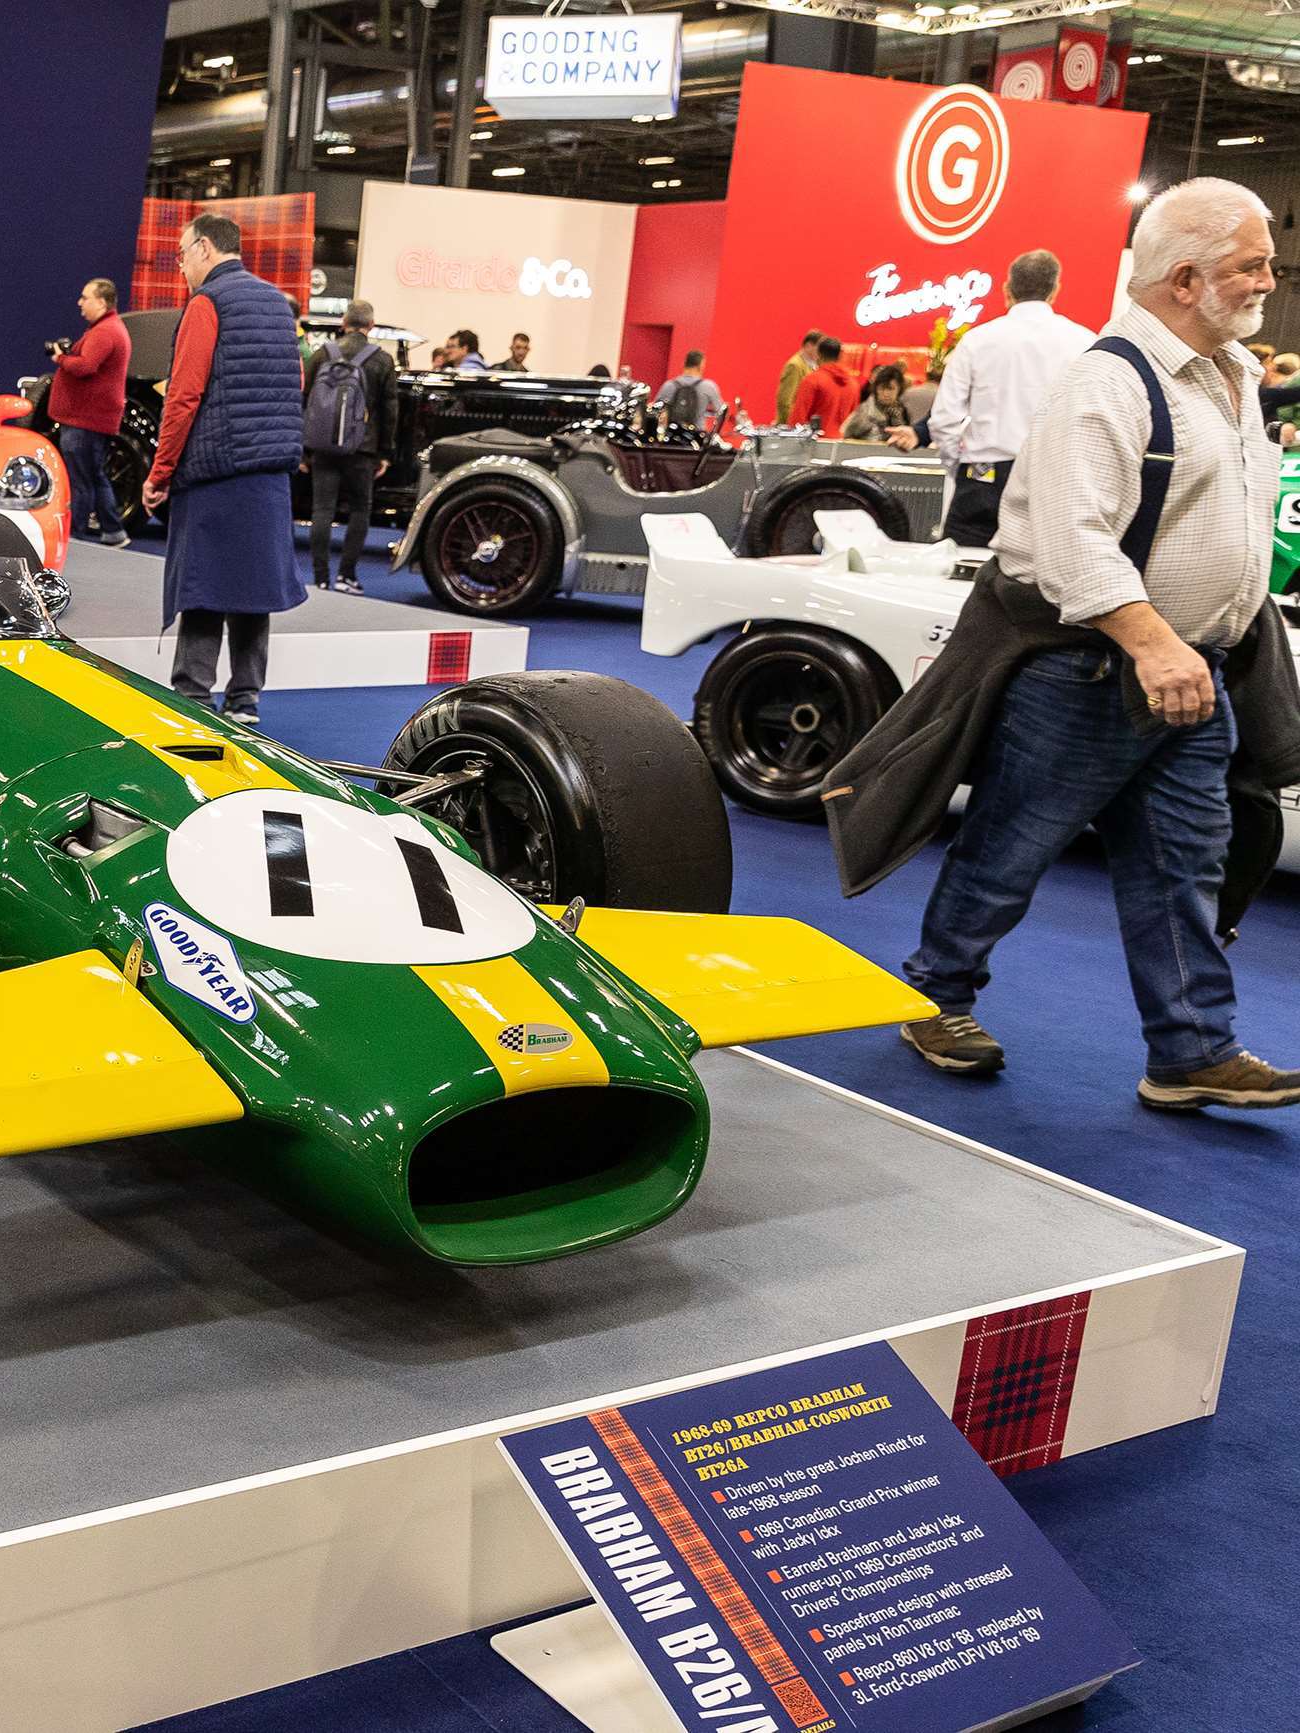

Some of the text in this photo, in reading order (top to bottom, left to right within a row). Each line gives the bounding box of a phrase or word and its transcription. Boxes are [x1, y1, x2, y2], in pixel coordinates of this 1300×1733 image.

[501, 30, 639, 55] GOODING
[928, 123, 982, 206] G
[262, 809, 465, 935] 11
[671, 1382, 867, 1446] 1968-69 REPCO BRABHAM
[682, 1395, 893, 1464] BT26/BRABHAM-COSWORTH
[694, 1456, 750, 1482] BT26A
[724, 1434, 927, 1500] Driven by the great Jochen Rindt for
[539, 1445, 697, 1623] BRABHAM
[722, 1484, 823, 1520] late-1968 season
[753, 1475, 941, 1539] 1969 Canadian Grand Prix winner
[751, 1524, 842, 1560] with Jacky Ickx
[780, 1514, 965, 1580] Earned Brabham and Jacky Ickx
[781, 1574, 842, 1601] runner-up
[838, 1568, 857, 1582] in
[854, 1557, 885, 1576] 1969
[960, 1524, 985, 1543] and
[822, 1563, 1014, 1639] Spaceframe design with stressed
[840, 1564, 934, 1602] Championships
[822, 1605, 961, 1664] panels by Ron Tauranac
[852, 1660, 896, 1682] Repco
[892, 1648, 919, 1668] 860
[912, 1642, 936, 1659] V8
[932, 1638, 954, 1653] for
[976, 1609, 1028, 1638] replaced
[1022, 1606, 1044, 1622] by
[851, 1688, 874, 1705] 3L
[868, 1656, 962, 1699] Ford-Cosworth
[956, 1645, 986, 1666] DFV
[980, 1640, 1004, 1657] V8
[999, 1635, 1021, 1651] for
